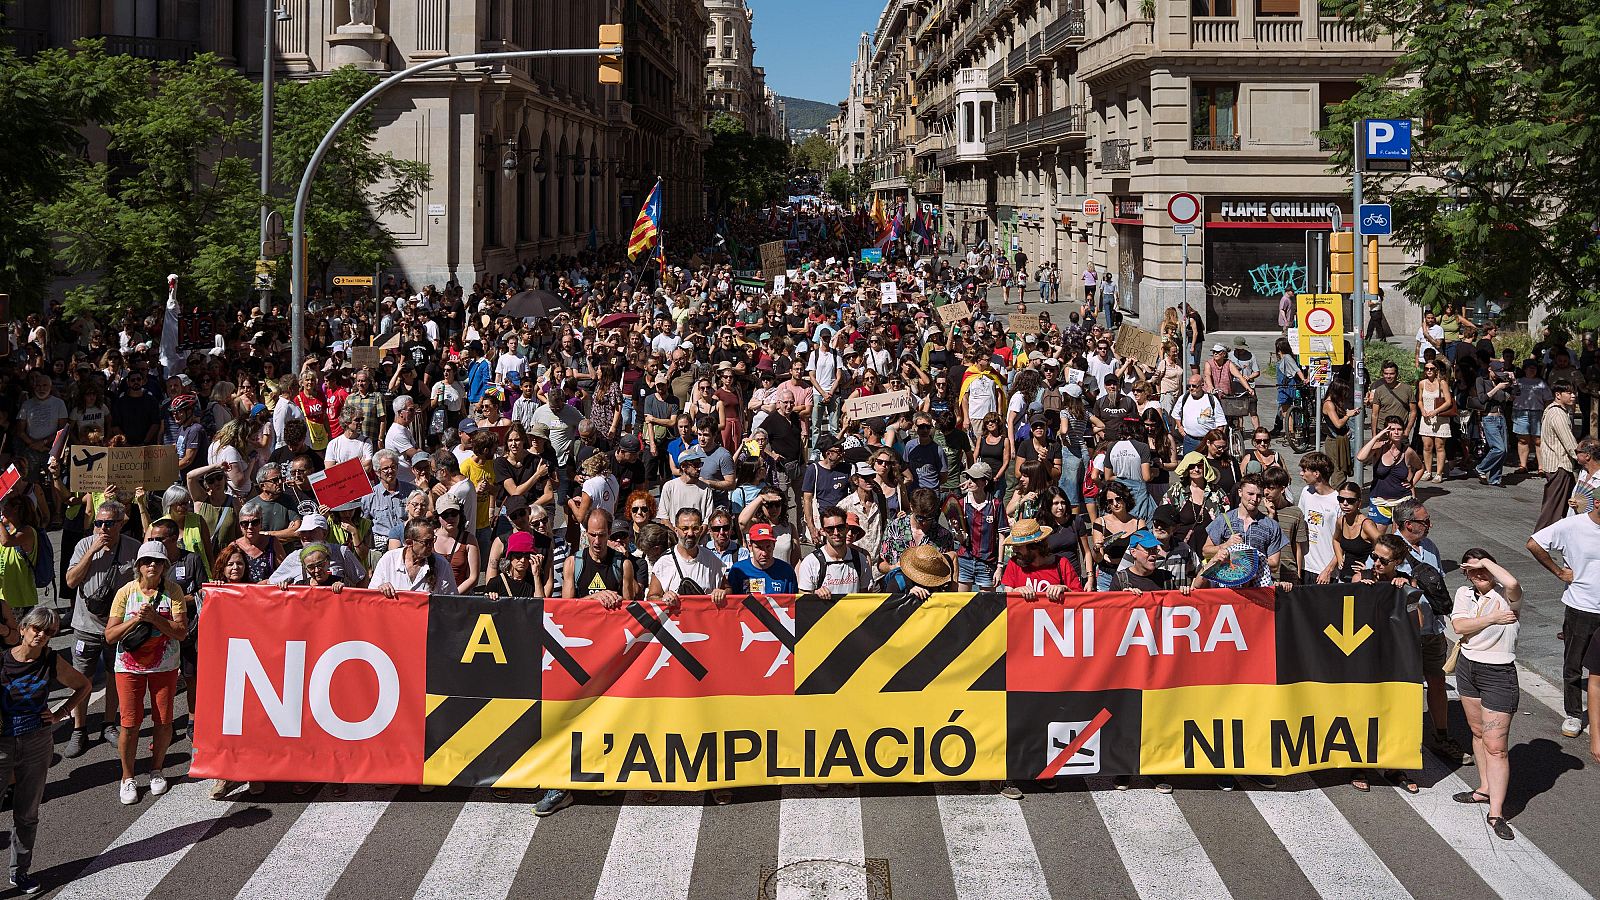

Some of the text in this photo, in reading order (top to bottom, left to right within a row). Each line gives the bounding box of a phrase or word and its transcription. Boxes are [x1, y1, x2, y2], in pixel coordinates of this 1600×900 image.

[1369, 122, 1394, 154] P
[1221, 201, 1267, 217] FLAME
[309, 404, 321, 412] NO
[861, 400, 880, 414] TREN
[83, 413, 102, 421] MIAMI
[111, 450, 134, 460] NOVA
[96, 463, 104, 471] A
[1026, 577, 1051, 593] NO
[460, 613, 508, 665] A
[1033, 604, 1249, 658] NI ARA
[222, 637, 401, 741] NO
[570, 710, 977, 783] L’AMPLIACIÓ
[1183, 716, 1378, 769] NI MAI
